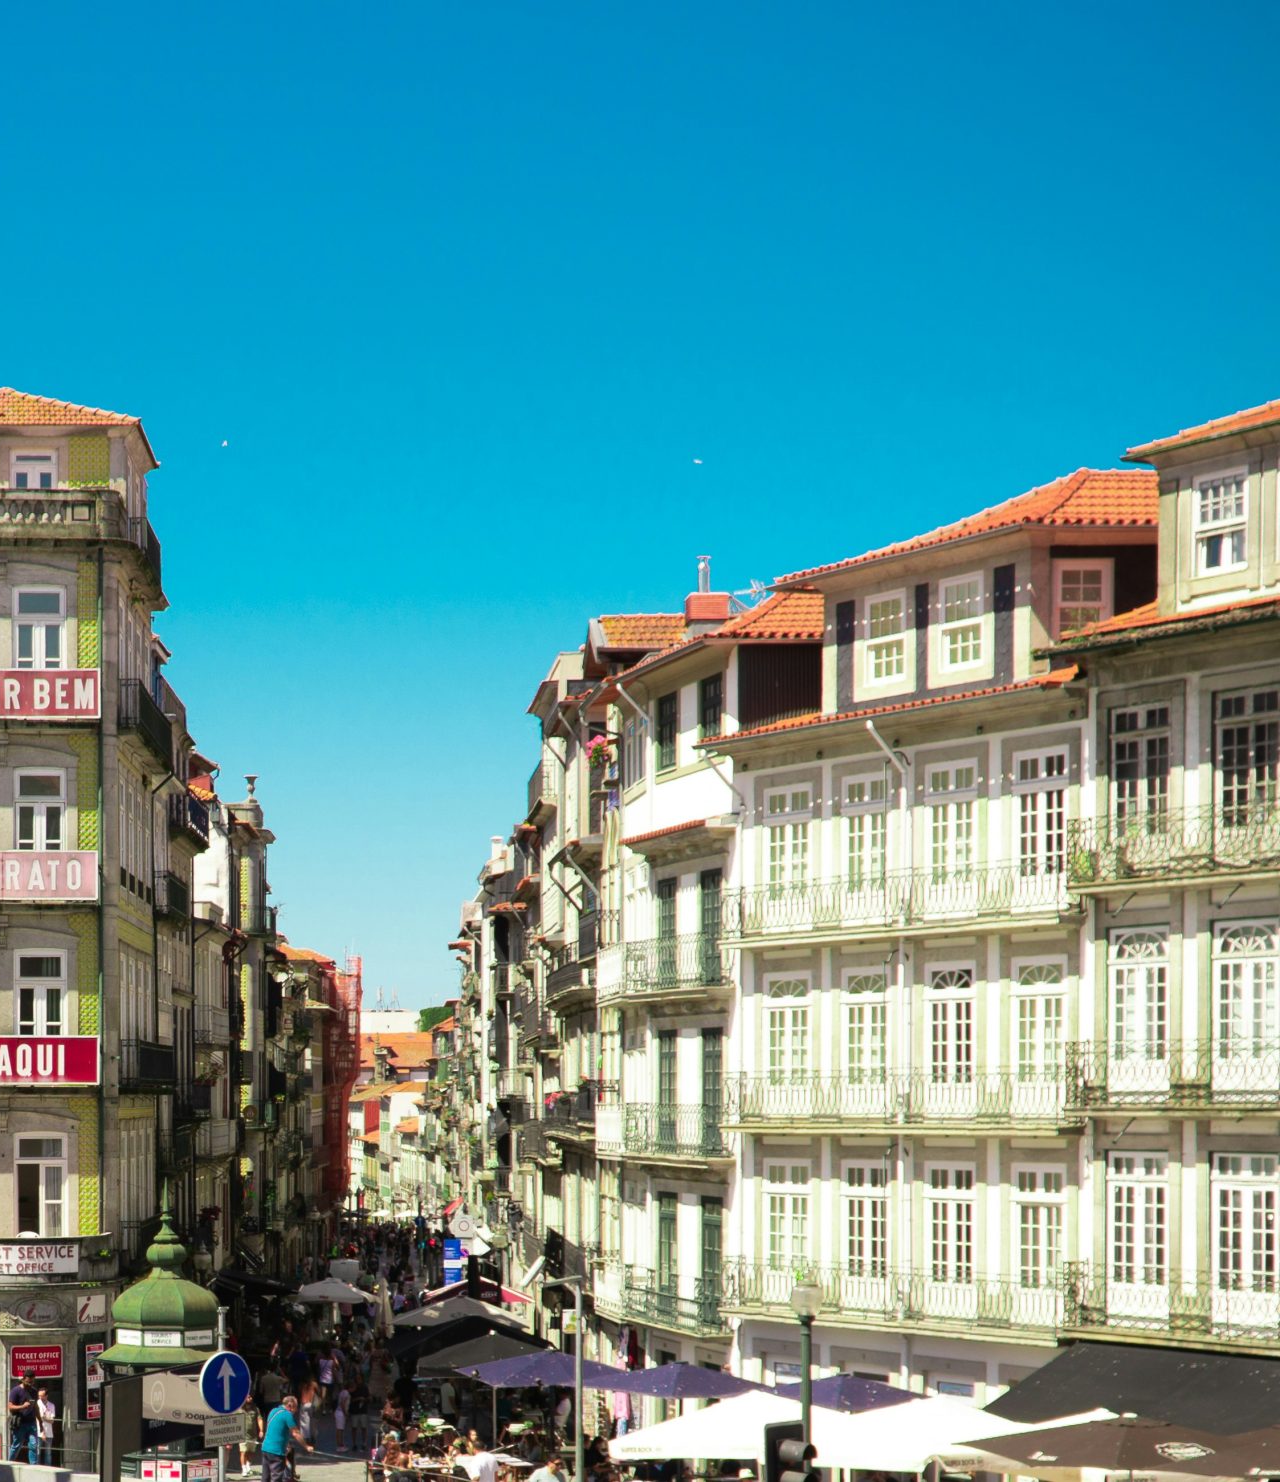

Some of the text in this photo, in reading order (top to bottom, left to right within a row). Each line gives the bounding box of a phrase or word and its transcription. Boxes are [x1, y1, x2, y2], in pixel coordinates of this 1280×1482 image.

[33, 678, 95, 710] BEM
[17, 1245, 75, 1259] SERVICE
[16, 1262, 54, 1273] OFFICE
[14, 1351, 60, 1360] TICKET OFFICE
